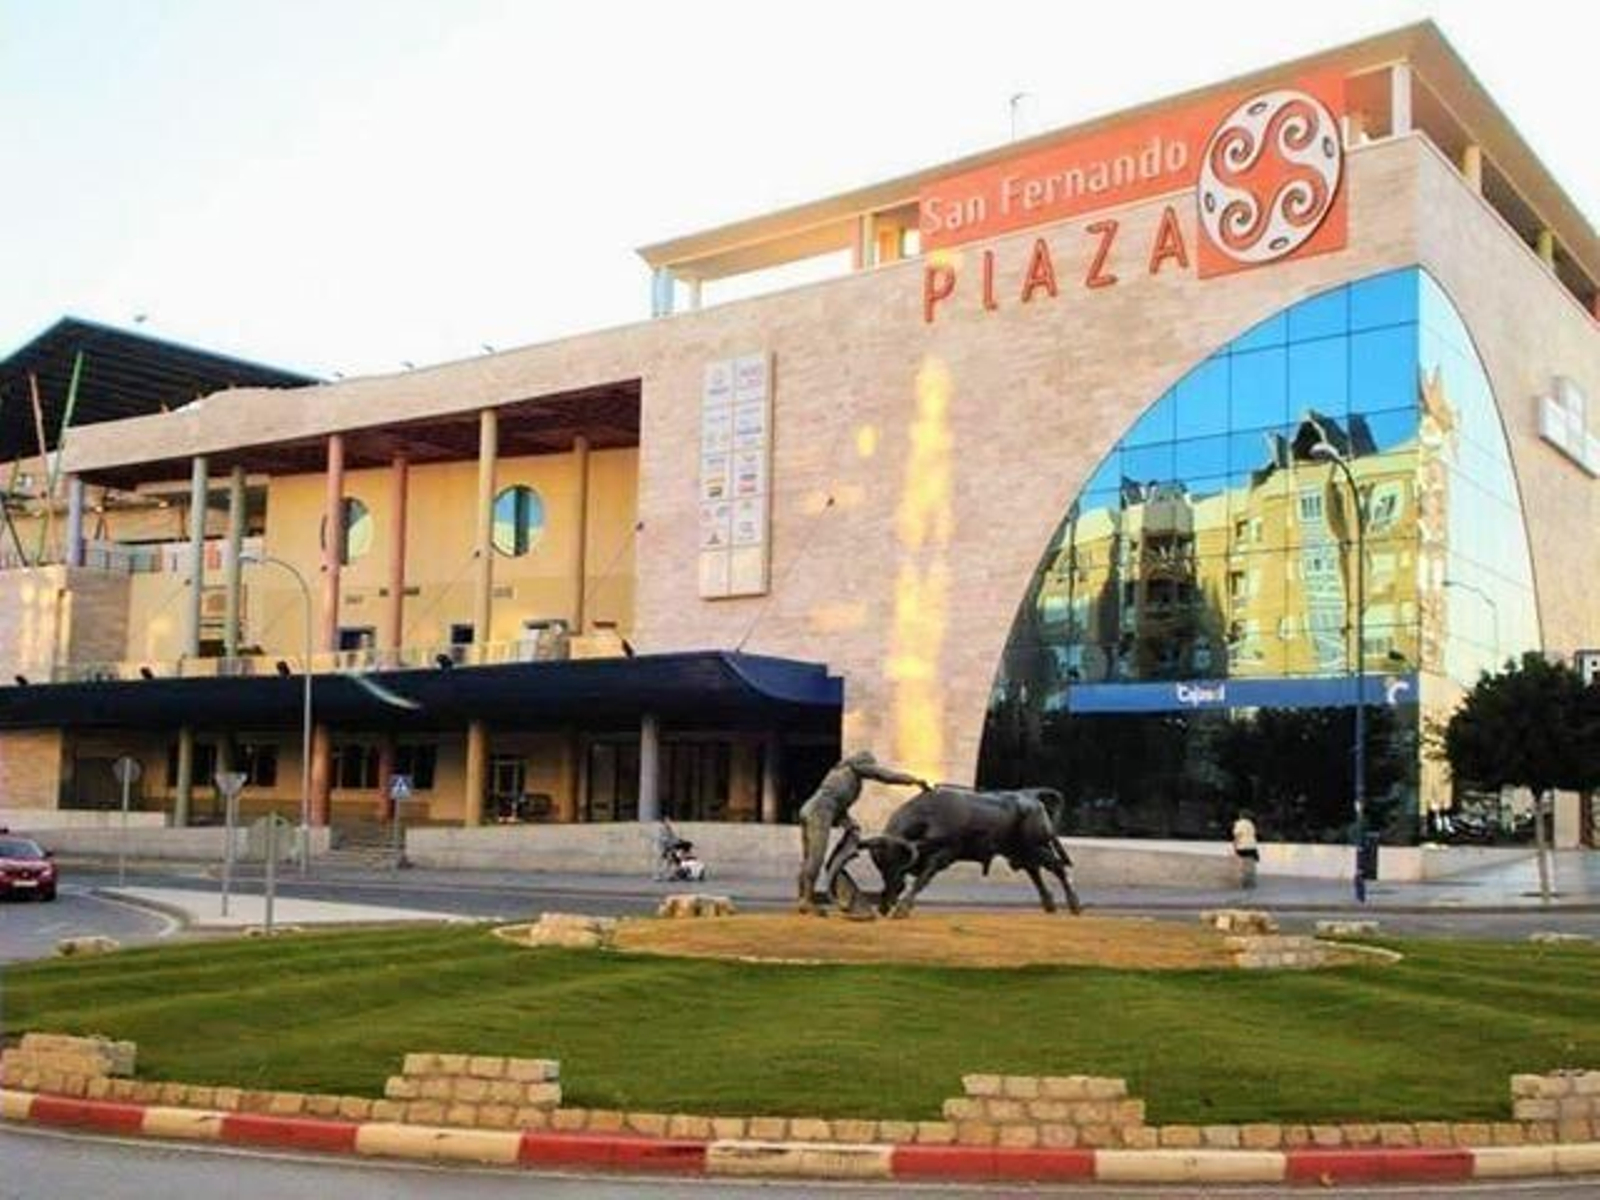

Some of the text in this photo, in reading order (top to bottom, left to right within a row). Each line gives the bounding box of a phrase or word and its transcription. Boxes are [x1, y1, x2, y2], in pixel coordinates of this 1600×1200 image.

[922, 138, 1189, 236] San Fernando
[923, 205, 1190, 323] PLAZA
